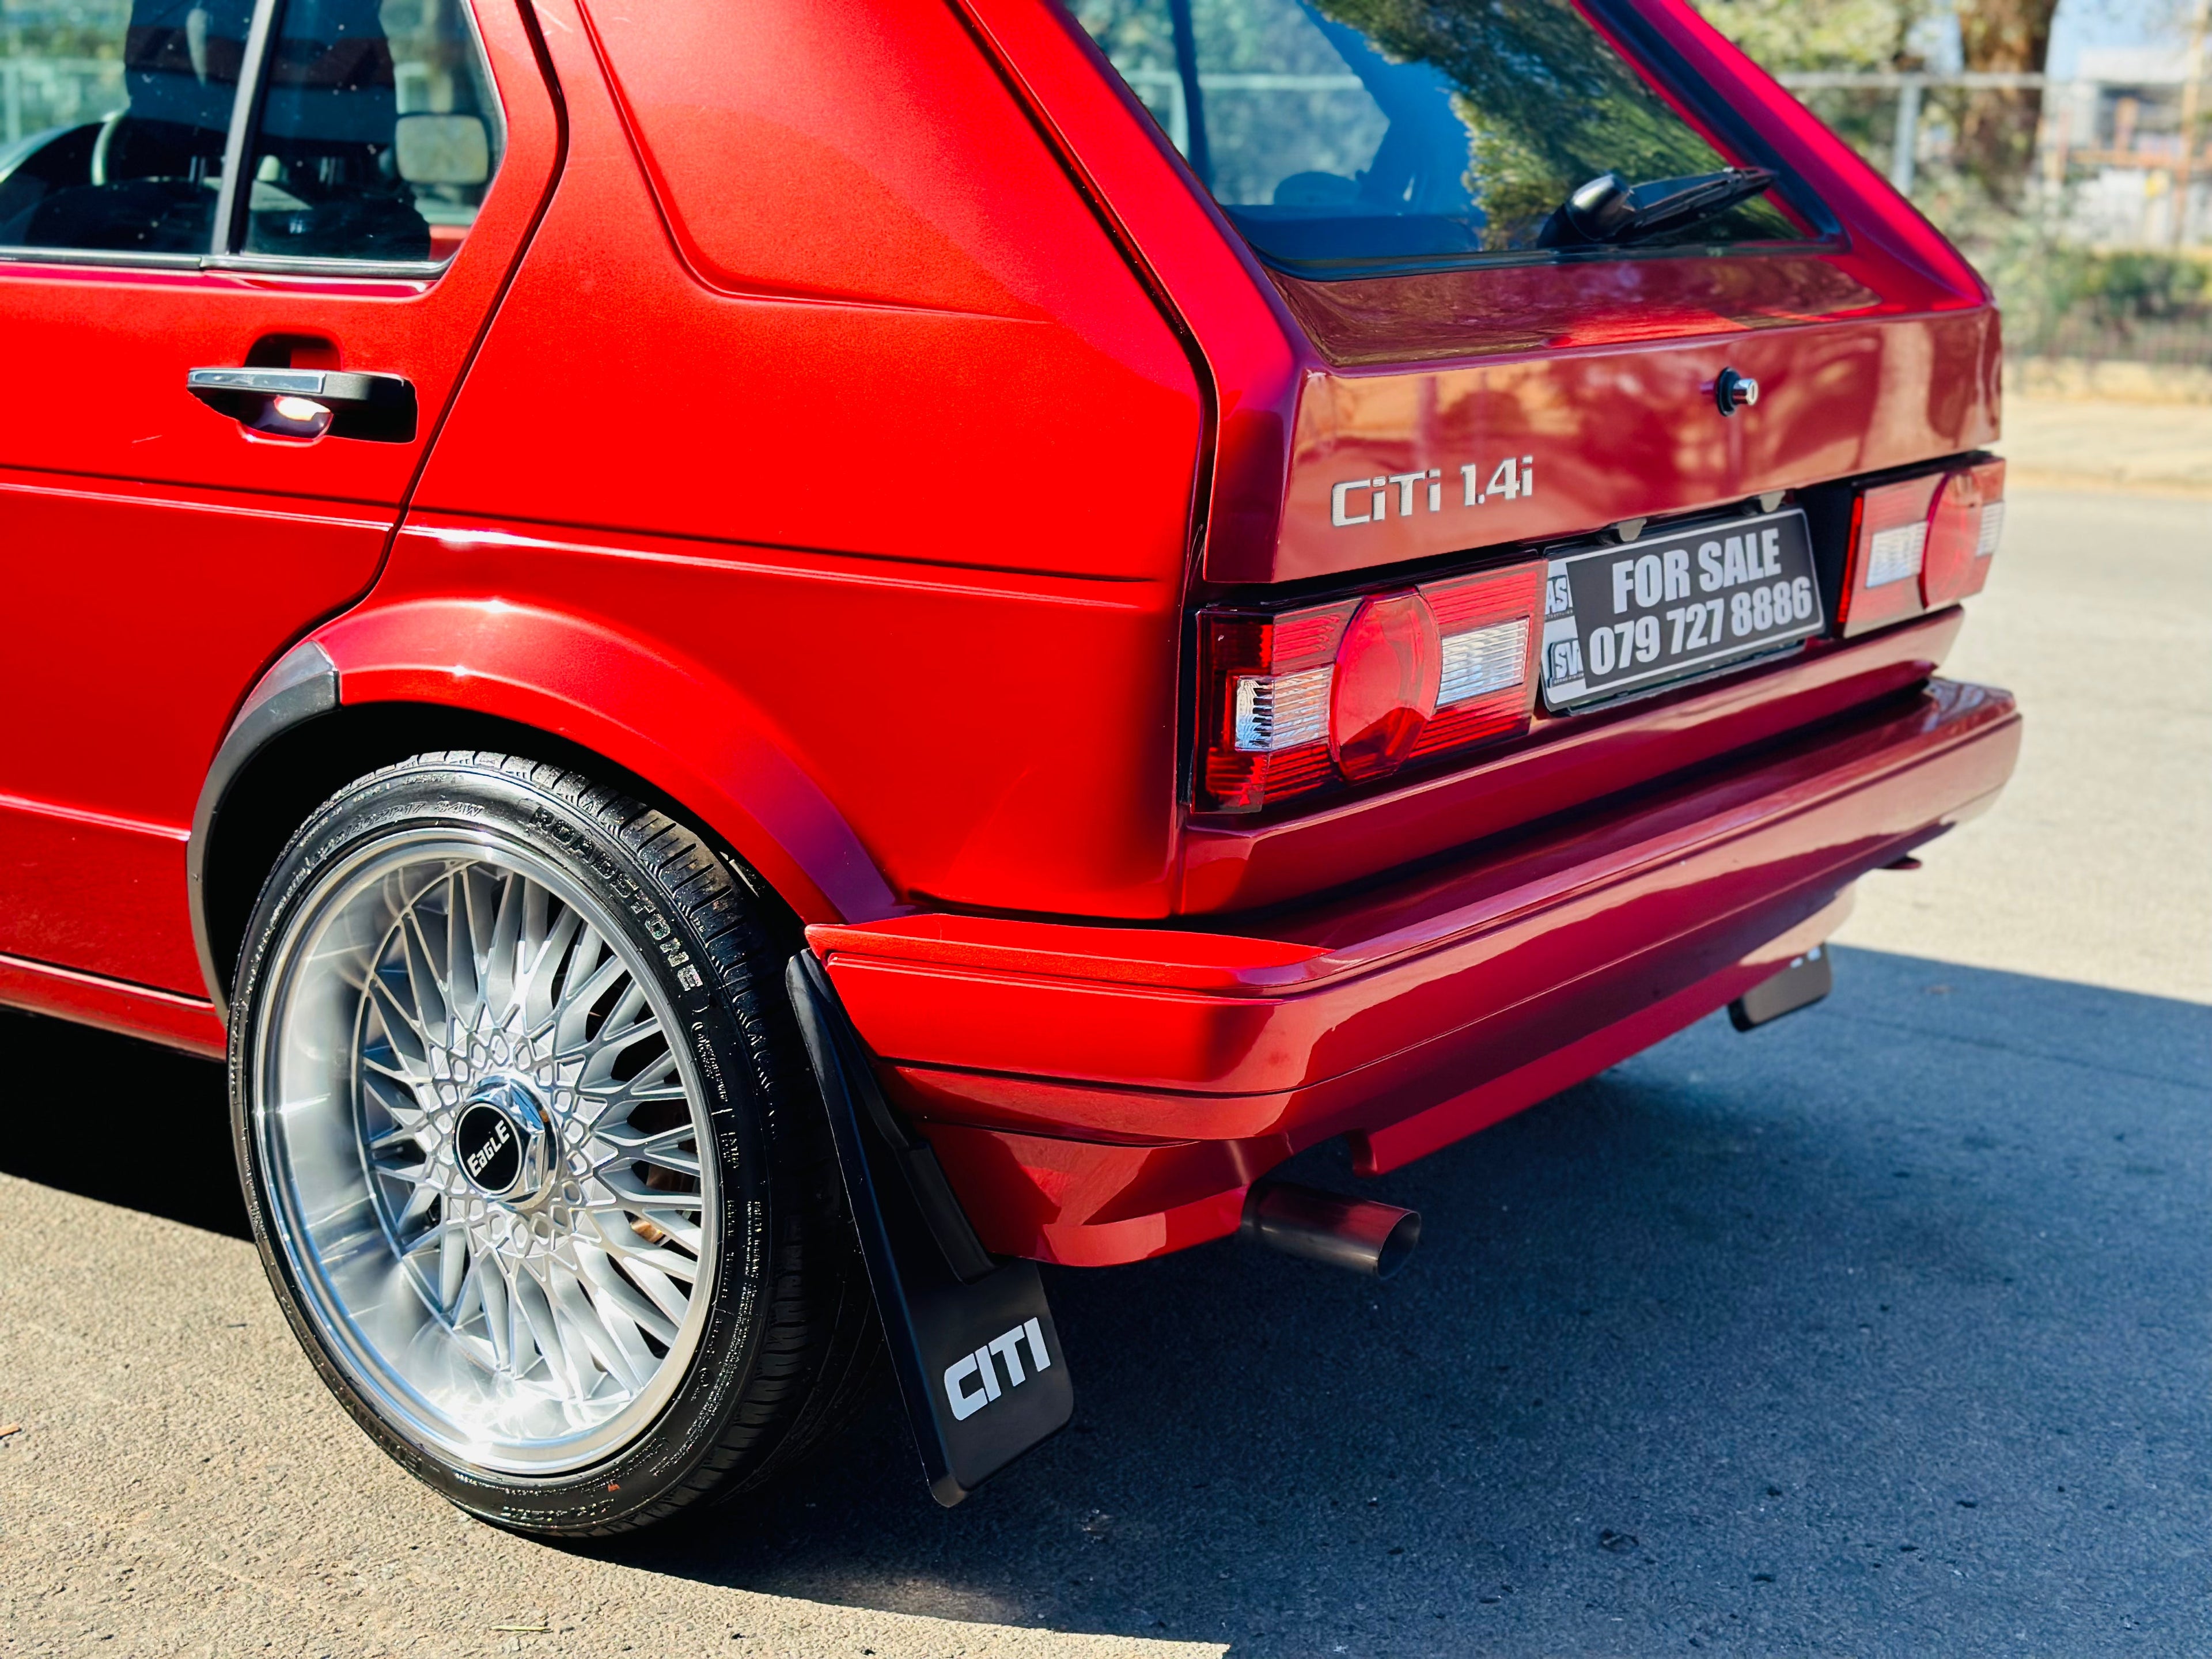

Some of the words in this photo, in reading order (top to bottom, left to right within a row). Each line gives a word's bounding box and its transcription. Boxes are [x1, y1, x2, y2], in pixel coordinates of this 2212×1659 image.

[1461, 455, 1533, 506] 1.4i
[1612, 549, 1691, 615] FOR
[1698, 528, 1782, 593] SALE
[1589, 615, 1661, 676] 079
[1666, 597, 1725, 656] 727
[1730, 576, 1812, 637] 8886
[528, 805, 704, 991] ROADSTONE
[944, 1316, 1051, 1421] CITI
